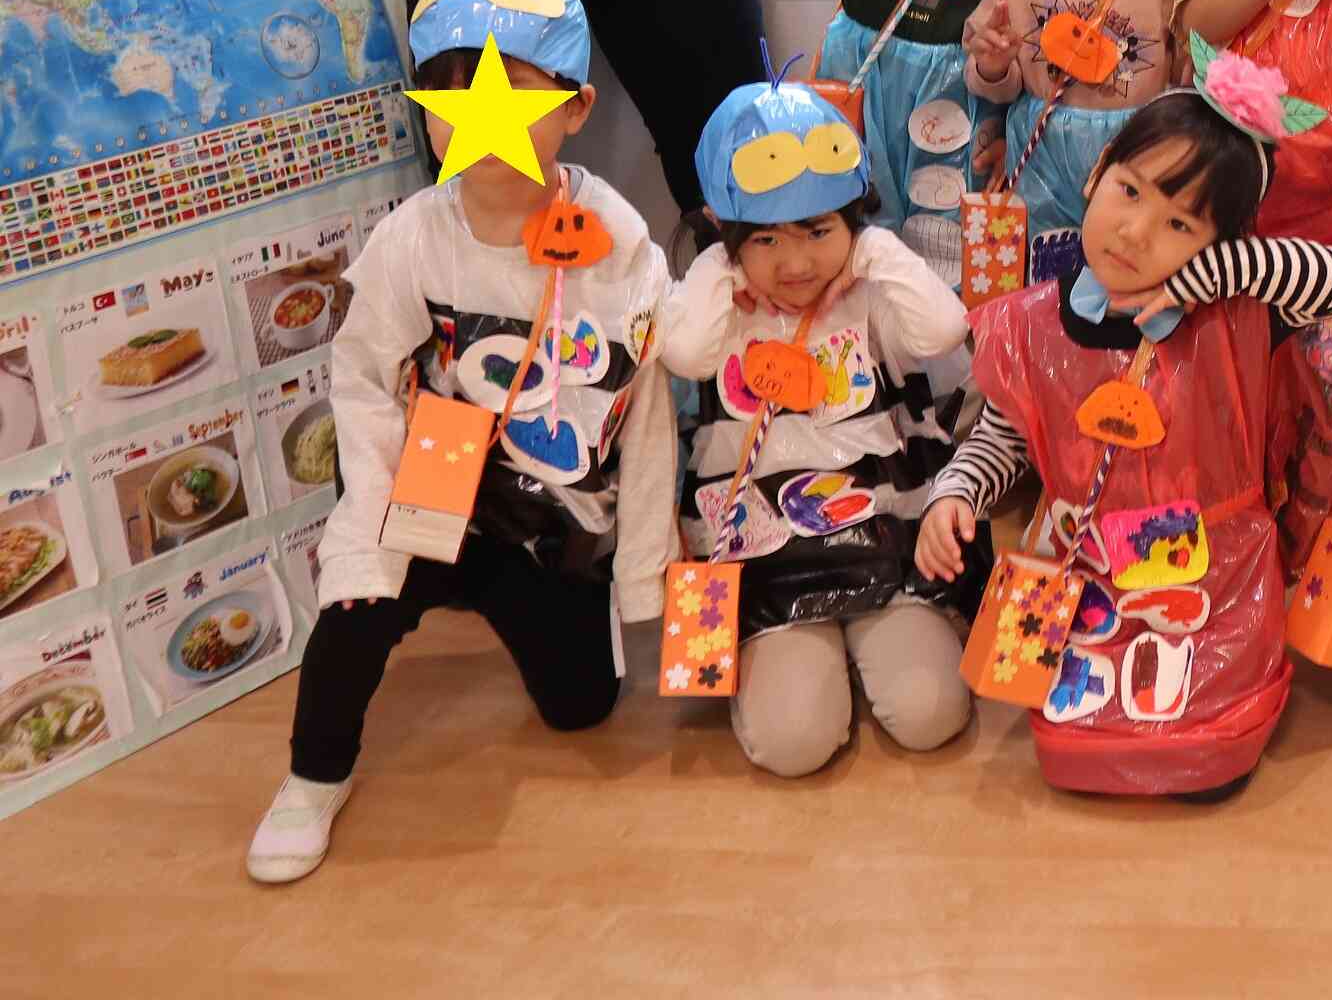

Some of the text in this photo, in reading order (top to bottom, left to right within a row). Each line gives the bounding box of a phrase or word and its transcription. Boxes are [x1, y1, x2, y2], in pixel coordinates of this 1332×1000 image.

[317, 229, 346, 248] June
[159, 269, 204, 298] May
[219, 549, 269, 582] January
